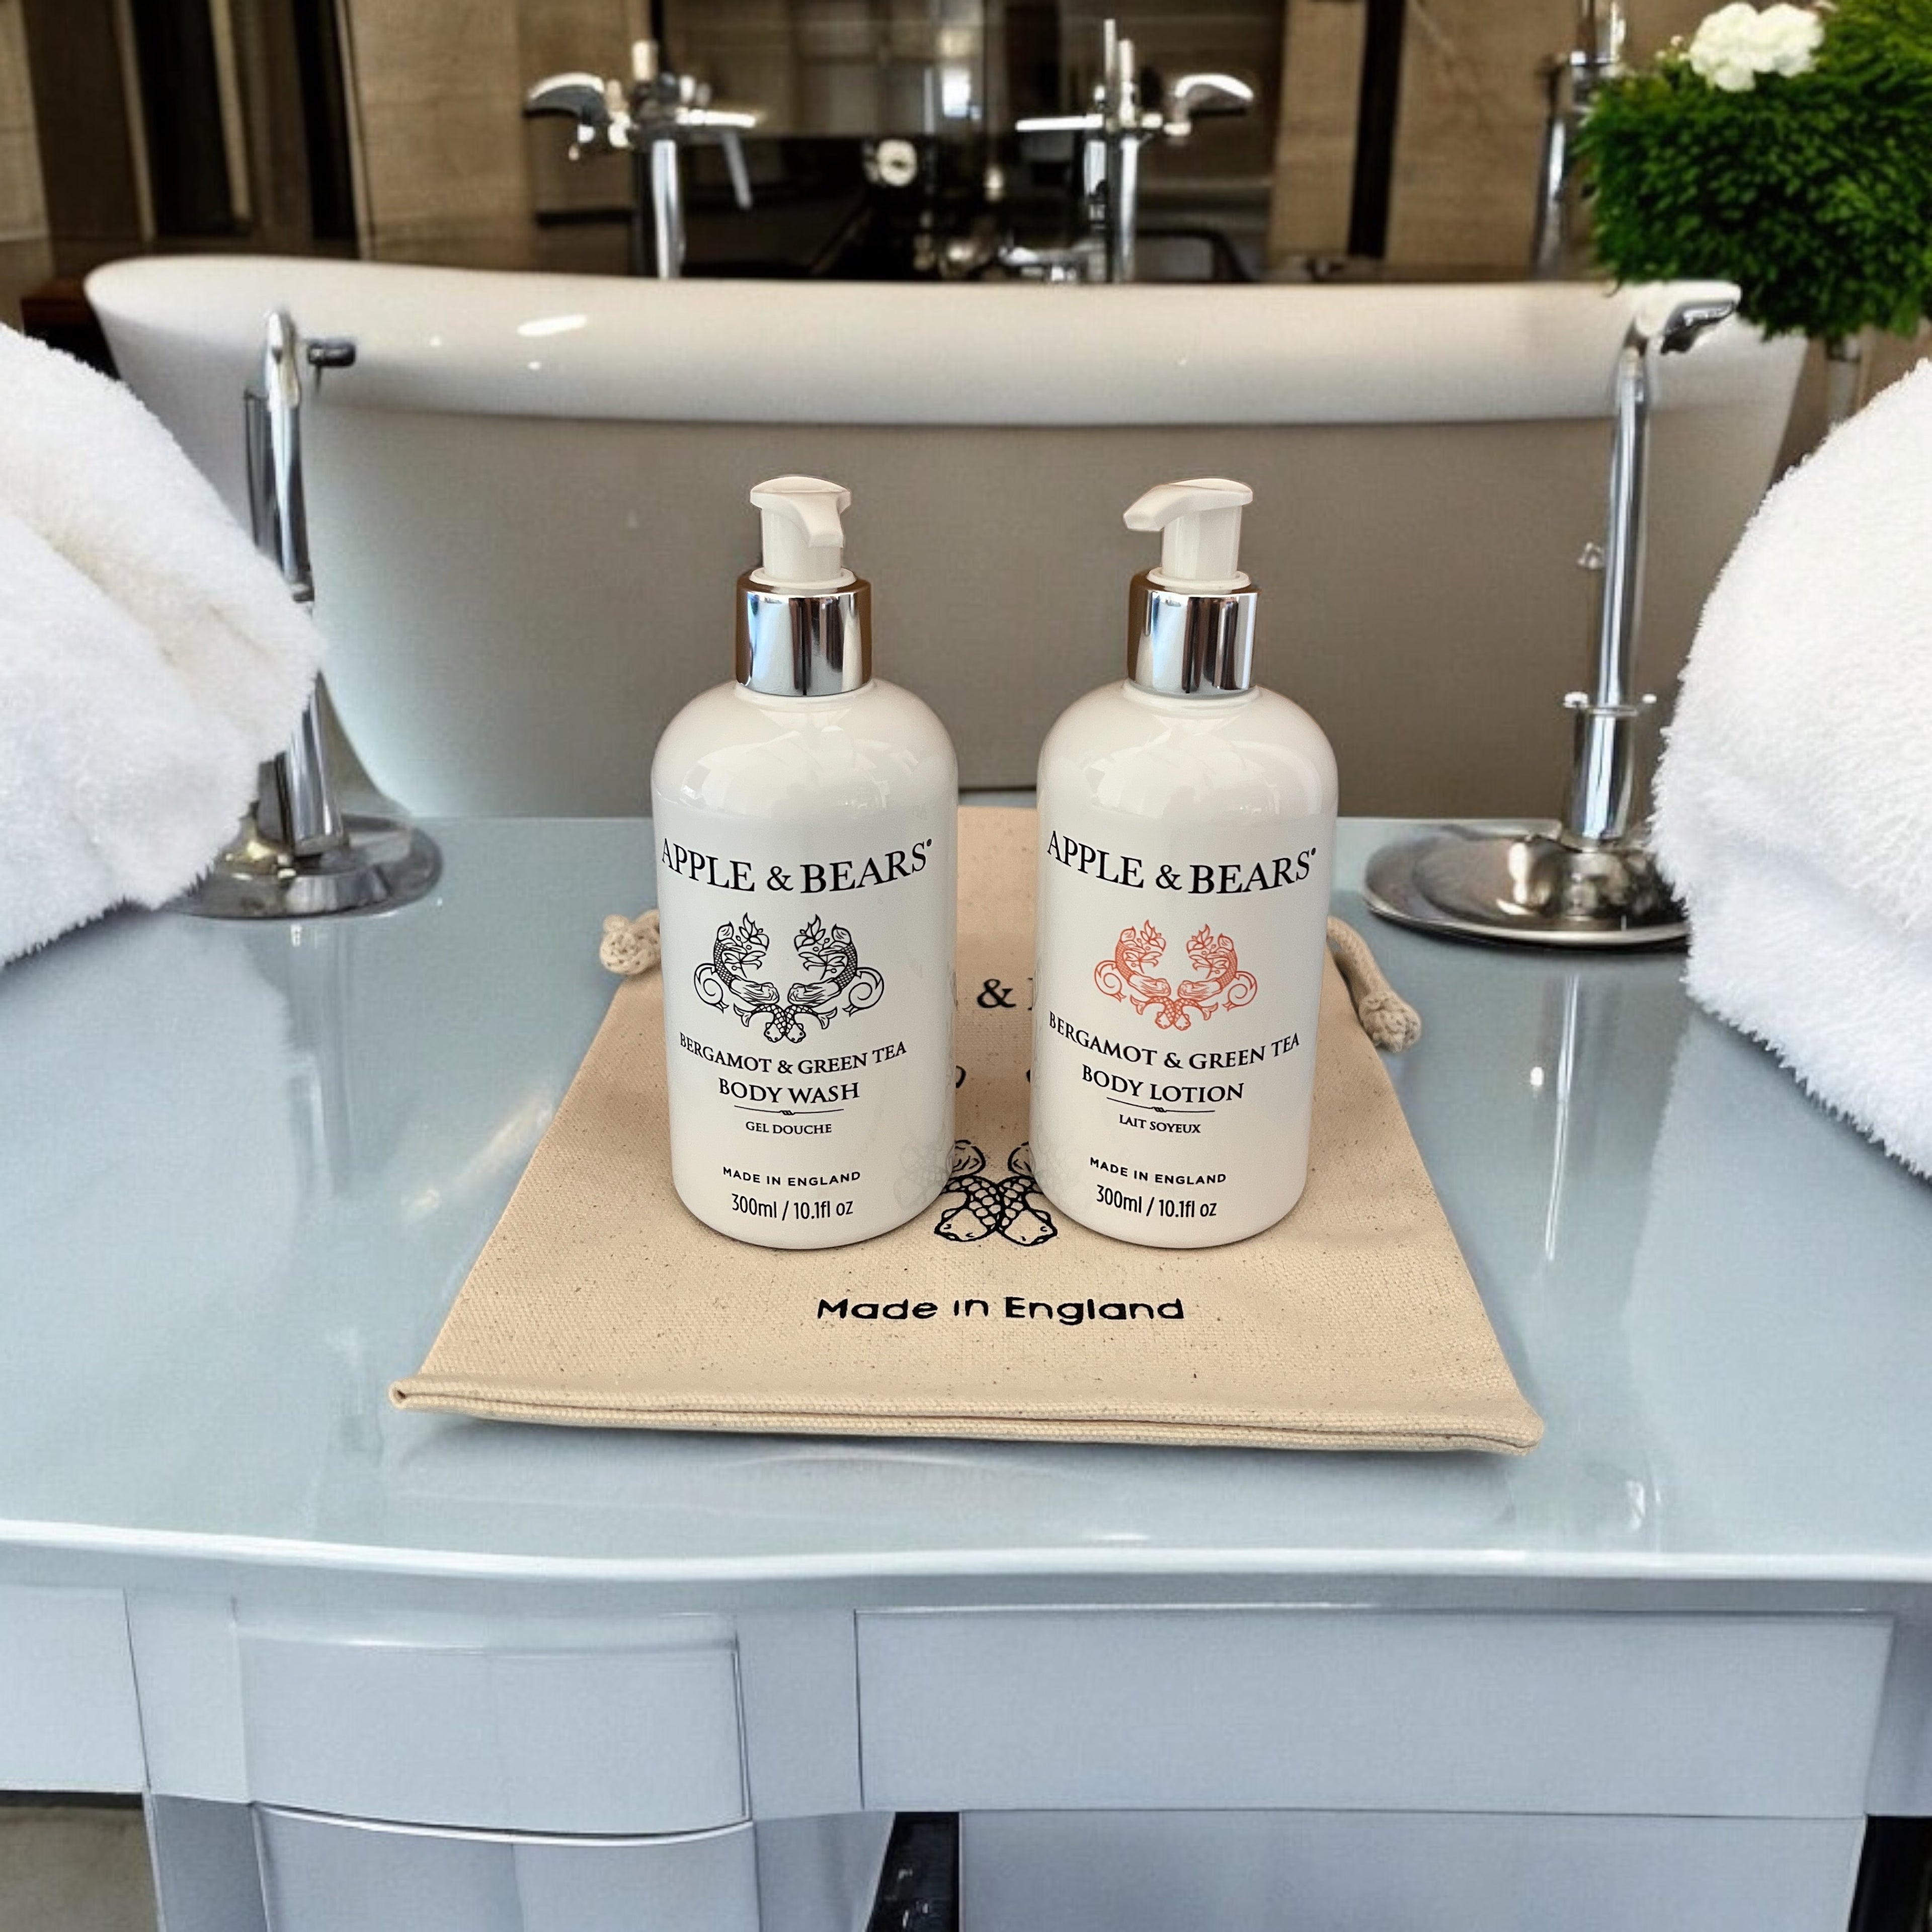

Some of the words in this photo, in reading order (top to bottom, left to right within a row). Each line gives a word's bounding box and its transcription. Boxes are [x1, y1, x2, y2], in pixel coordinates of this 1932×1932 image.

[662, 838, 755, 892] APPLE
[767, 866, 794, 891] &
[1047, 830, 1144, 889] APPLE
[1156, 864, 1182, 891] &
[977, 979, 1016, 1009] &
[680, 1032, 772, 1073] BERGAMOT
[777, 1060, 793, 1074] &
[797, 1052, 868, 1074] GREEN
[872, 1041, 907, 1064] TEA
[1049, 1011, 1158, 1066] BERGAMOT
[1164, 1052, 1183, 1069] &
[1189, 1045, 1266, 1070] GREEN
[1271, 1032, 1300, 1057] TEA
[718, 1077, 783, 1103] BODY
[787, 1082, 860, 1104] WASH
[1082, 1064, 1144, 1097] BODY
[1150, 1082, 1244, 1103] LOTION
[746, 1121, 769, 1133] GEL
[772, 1123, 832, 1135] DOUCHE
[1119, 1114, 1147, 1129] LAIT
[1149, 1121, 1201, 1134] SOYEUX
[723, 1166, 761, 1183] MADE
[767, 1175, 781, 1185] IN
[788, 1171, 860, 1186] ENGLAND
[1090, 1157, 1128, 1177] MADE
[1134, 1170, 1148, 1181] IN
[1155, 1174, 1226, 1185] ENGLAND
[732, 1193, 777, 1218] 300ml
[781, 1200, 789, 1221] /
[793, 1200, 830, 1220] 10.1fl
[836, 1200, 853, 1216] oz
[1096, 1184, 1142, 1214] 300ml
[1146, 1196, 1155, 1217] /
[1159, 1199, 1195, 1218] 10.1fl
[1200, 1202, 1217, 1217] oz
[817, 1298, 938, 1320] Made
[953, 1299, 989, 1317] in
[1005, 1296, 1184, 1326] England
